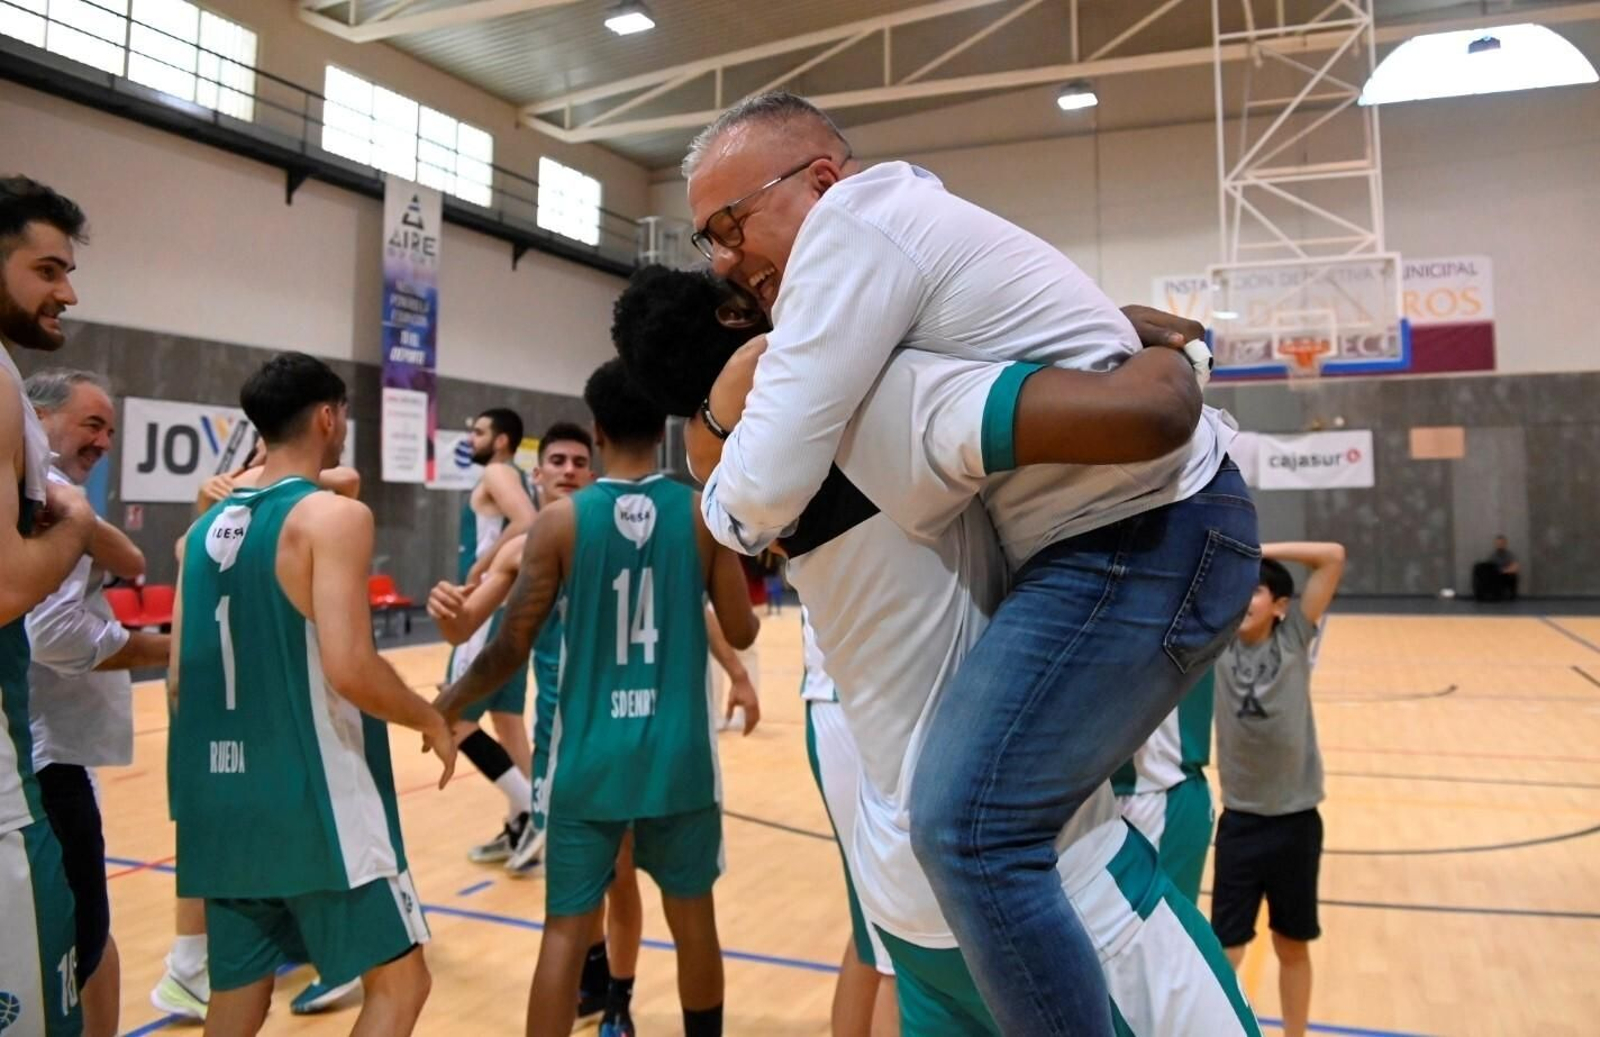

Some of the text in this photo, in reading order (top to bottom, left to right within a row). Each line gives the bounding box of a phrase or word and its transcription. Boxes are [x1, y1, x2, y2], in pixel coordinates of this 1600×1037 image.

[389, 228, 436, 257] AIRE
[1269, 452, 1342, 472] cajasur
[612, 567, 659, 666] 14
[215, 595, 237, 711] 1
[209, 740, 246, 774] RUEDA
